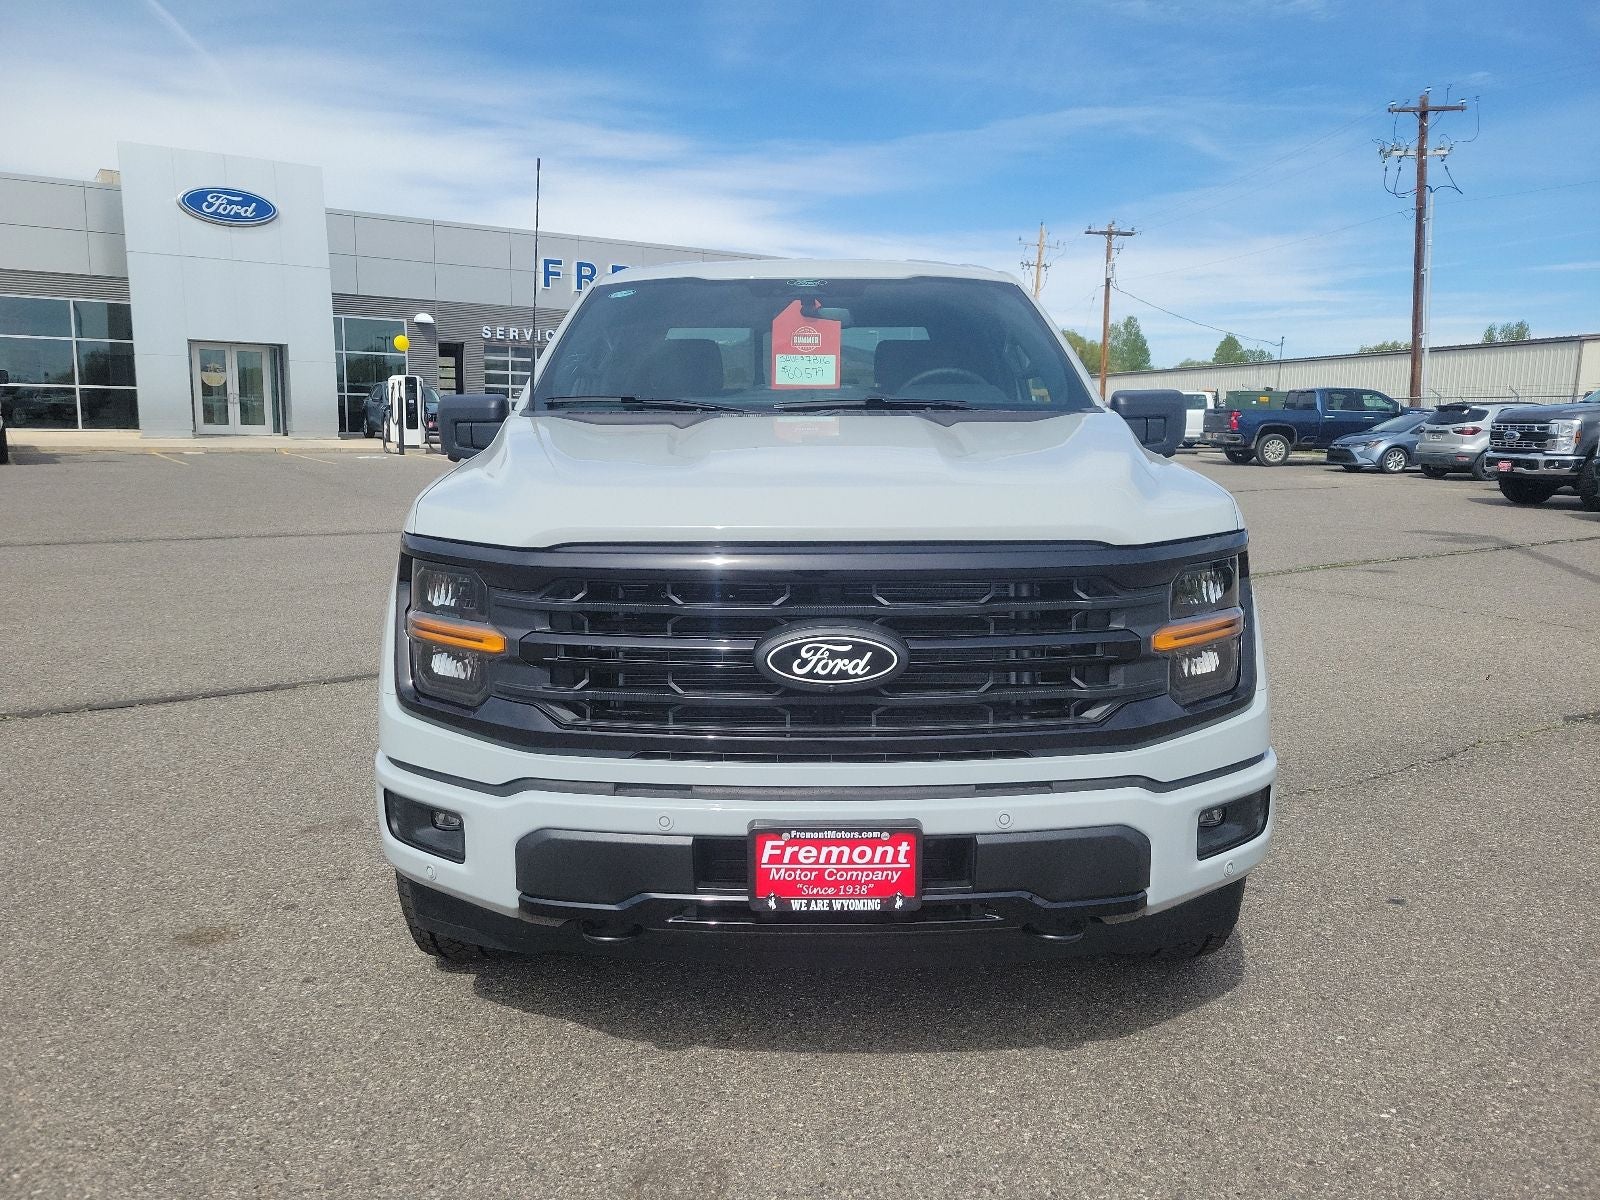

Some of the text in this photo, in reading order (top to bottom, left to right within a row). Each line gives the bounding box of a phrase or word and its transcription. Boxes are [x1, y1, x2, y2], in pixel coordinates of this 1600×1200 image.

[202, 193, 256, 217] Ford
[542, 258, 631, 292] FR
[792, 643, 873, 675] Ford
[790, 830, 881, 839] FremontMotors.com
[761, 840, 911, 864] Fremont
[769, 868, 902, 883] Motor Company
[796, 884, 875, 895] "Since 1938"
[790, 899, 881, 911] WE ARE WYOMING
